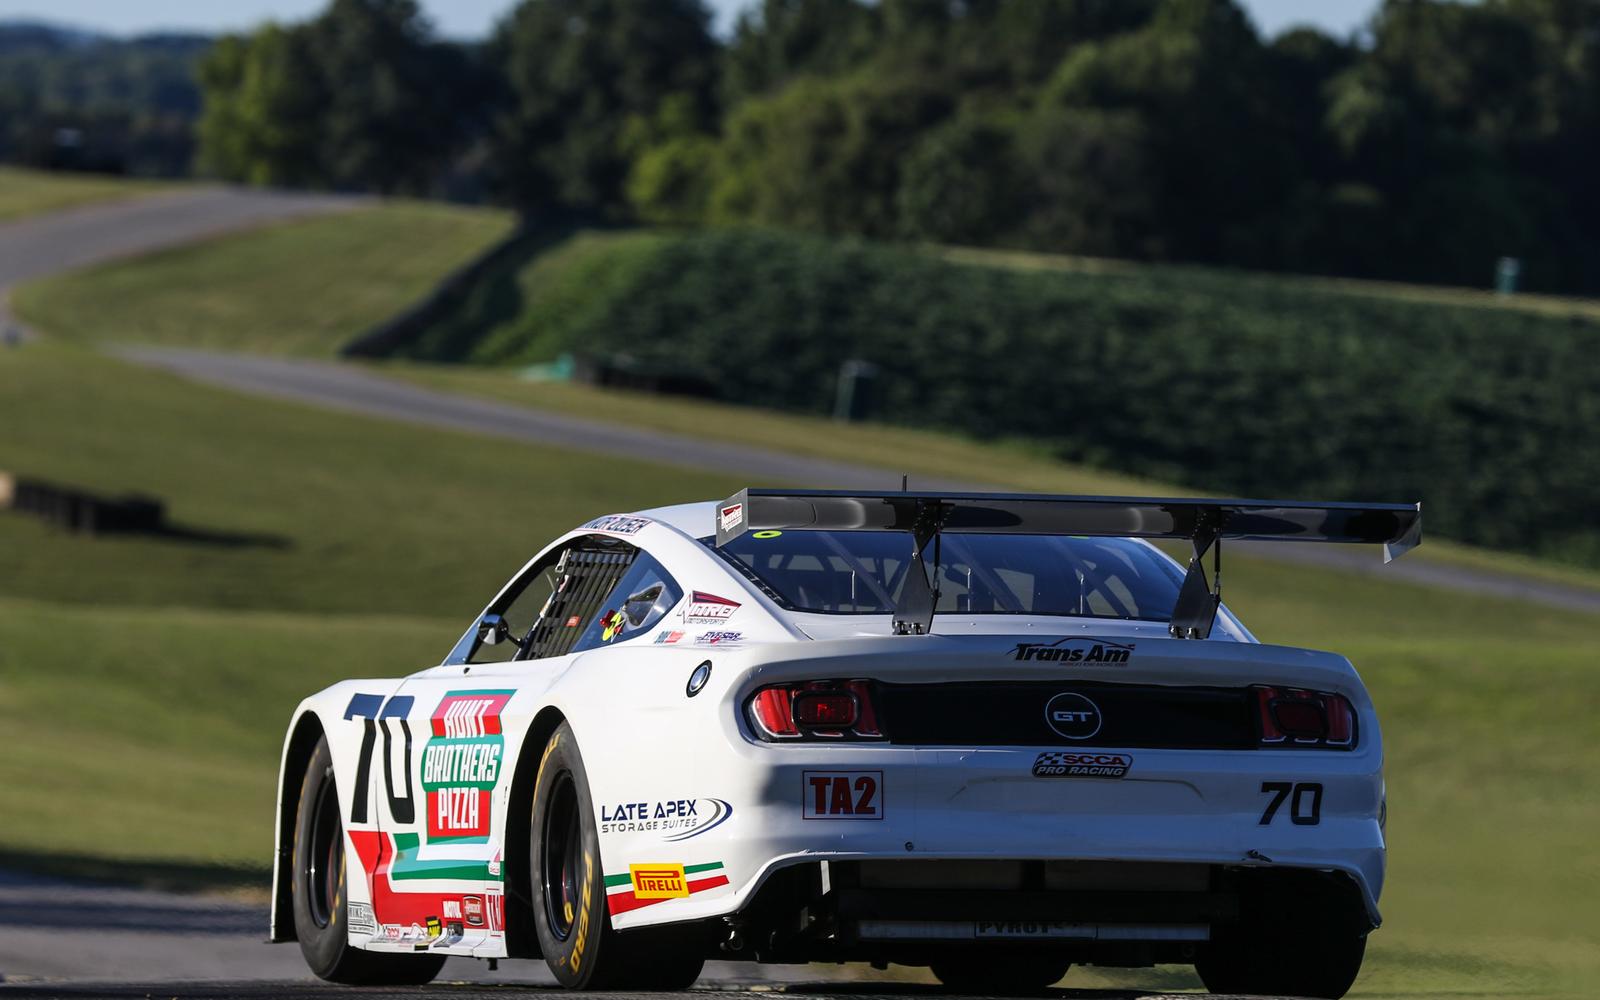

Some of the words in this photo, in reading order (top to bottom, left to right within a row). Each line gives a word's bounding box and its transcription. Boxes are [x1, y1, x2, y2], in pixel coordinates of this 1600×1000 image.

[1016, 643, 1084, 661] Trans
[1084, 644, 1131, 662] Am
[443, 699, 495, 739] HUNT
[1053, 711, 1093, 722] GT
[343, 693, 415, 824] 70
[424, 743, 501, 783] BROTHERS
[1062, 755, 1126, 766] SCCA
[1037, 766, 1065, 775] PRO
[1069, 767, 1124, 776] RACING
[809, 776, 876, 815] TA2
[1259, 782, 1323, 826] 70
[438, 787, 479, 829] PIZZA
[601, 804, 648, 822] LATE
[653, 800, 697, 819] APEX
[602, 822, 658, 833] STORAGE
[661, 819, 697, 829] SUITES
[635, 871, 682, 891] PIRELLI
